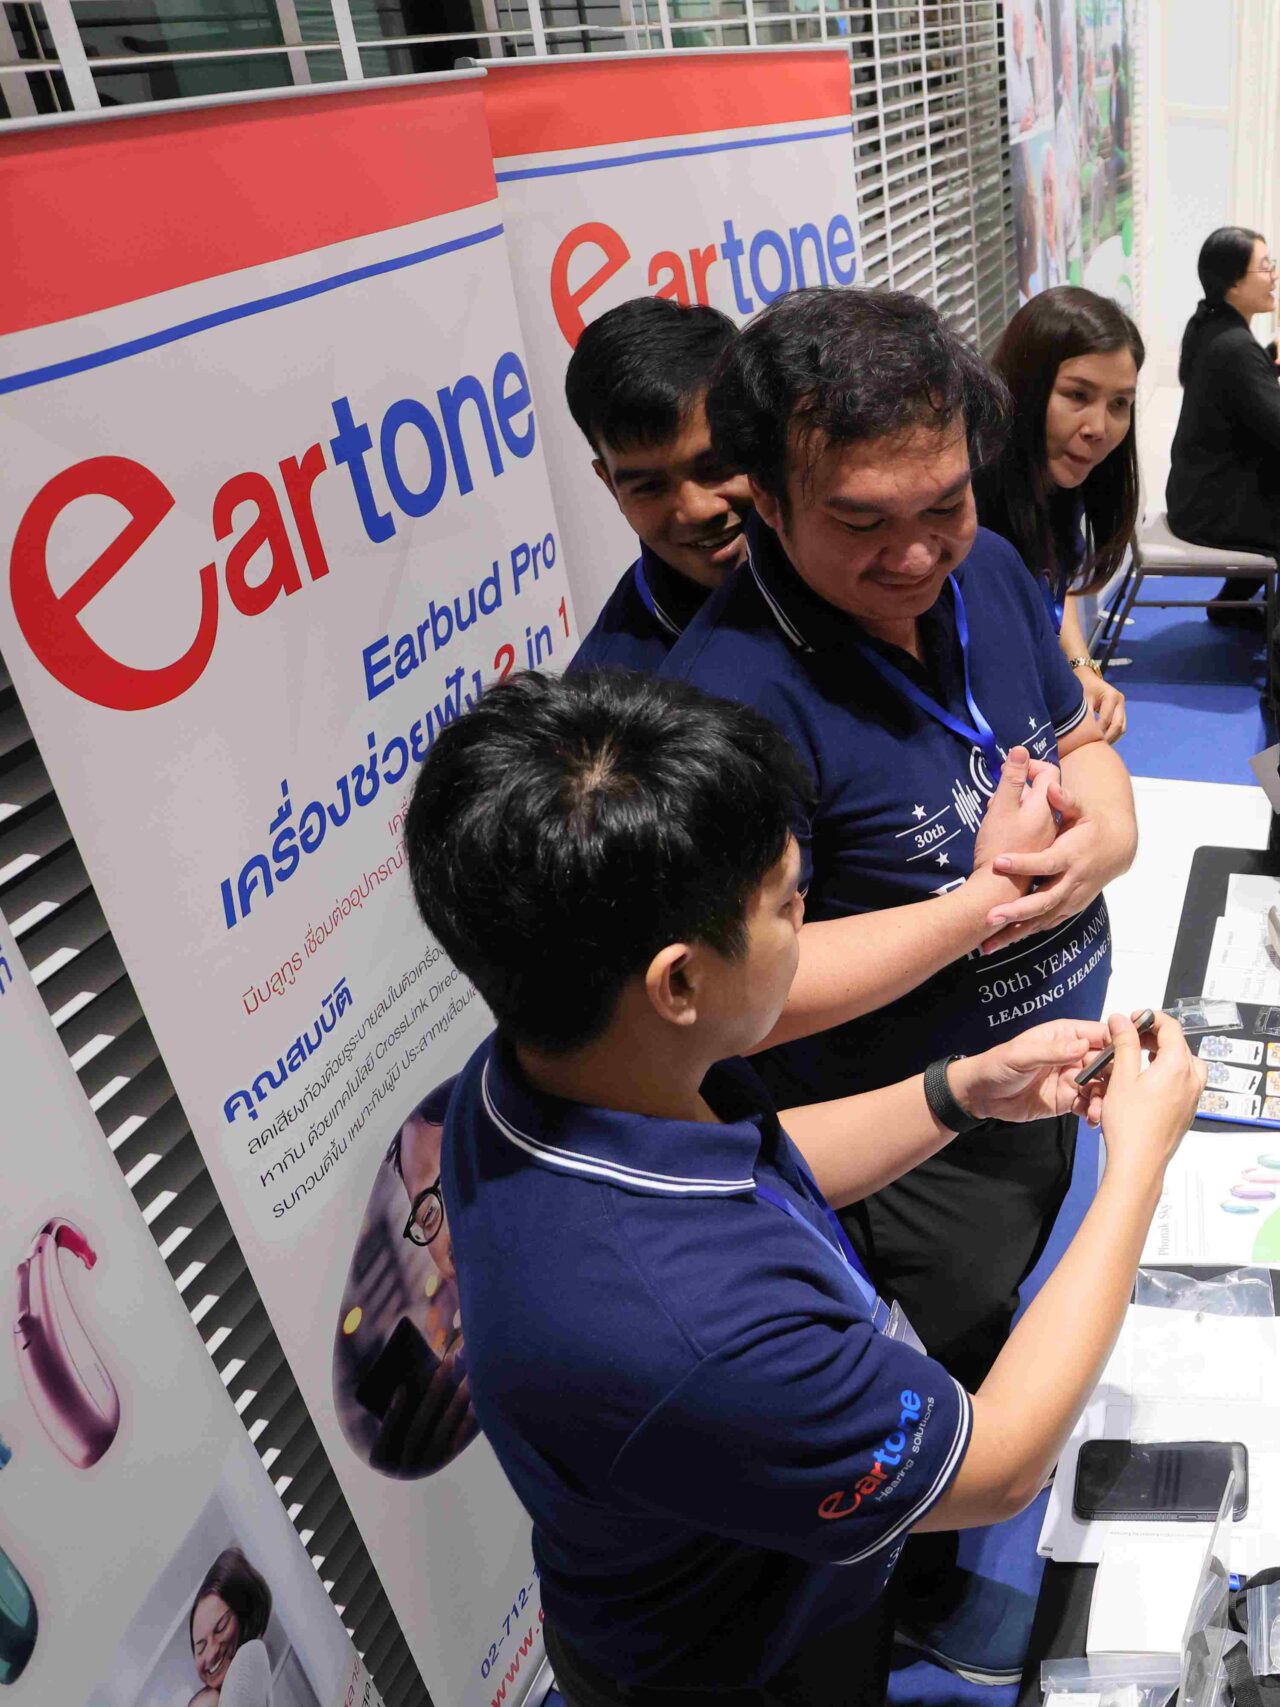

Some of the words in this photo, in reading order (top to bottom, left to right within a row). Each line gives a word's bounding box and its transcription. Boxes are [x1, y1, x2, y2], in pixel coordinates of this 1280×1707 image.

[551, 214, 857, 351] eartone
[9, 351, 536, 711] eartone
[362, 561, 502, 701] Earbud
[511, 532, 556, 596] Pro
[494, 643, 516, 686] 2
[526, 625, 553, 670] in
[558, 597, 570, 639] 1
[914, 823, 947, 849] 30th
[978, 971, 1032, 1003] 30th
[1033, 940, 1082, 983] YEAR
[987, 984, 1065, 1028] LEADING
[1067, 940, 1108, 995] HEARING
[223, 977, 354, 1124] คุณสมบัติ
[259, 1143, 306, 1187] หากัน
[375, 998, 430, 1060] CrossLink
[428, 968, 459, 1002] Direc
[817, 1389, 922, 1520] eartone
[875, 1459, 915, 1502] Hearing
[912, 1396, 935, 1454] solutions
[490, 1607, 545, 1707] www.e
